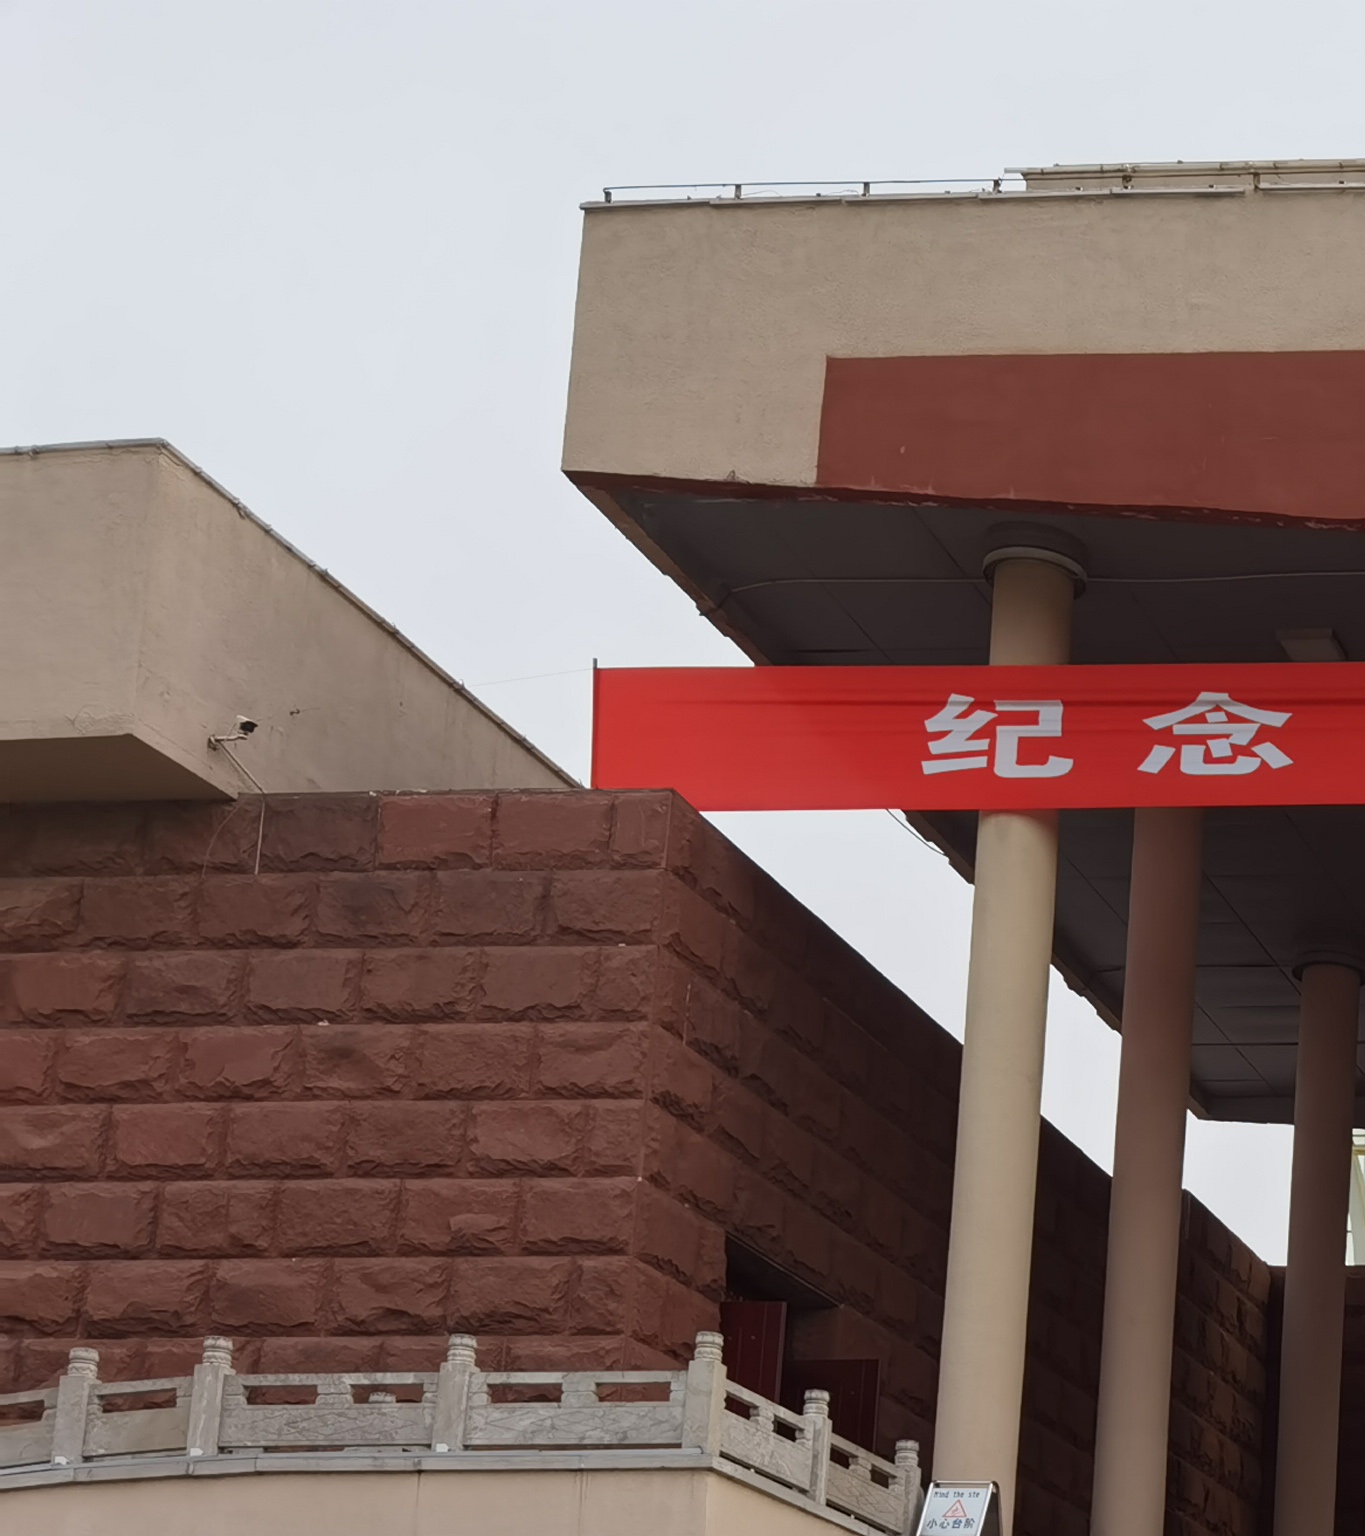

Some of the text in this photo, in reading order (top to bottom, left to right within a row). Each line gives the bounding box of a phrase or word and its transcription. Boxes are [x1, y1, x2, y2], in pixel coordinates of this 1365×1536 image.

[953, 1490, 964, 1498] the
[927, 1518, 975, 1529] 小心台阶
